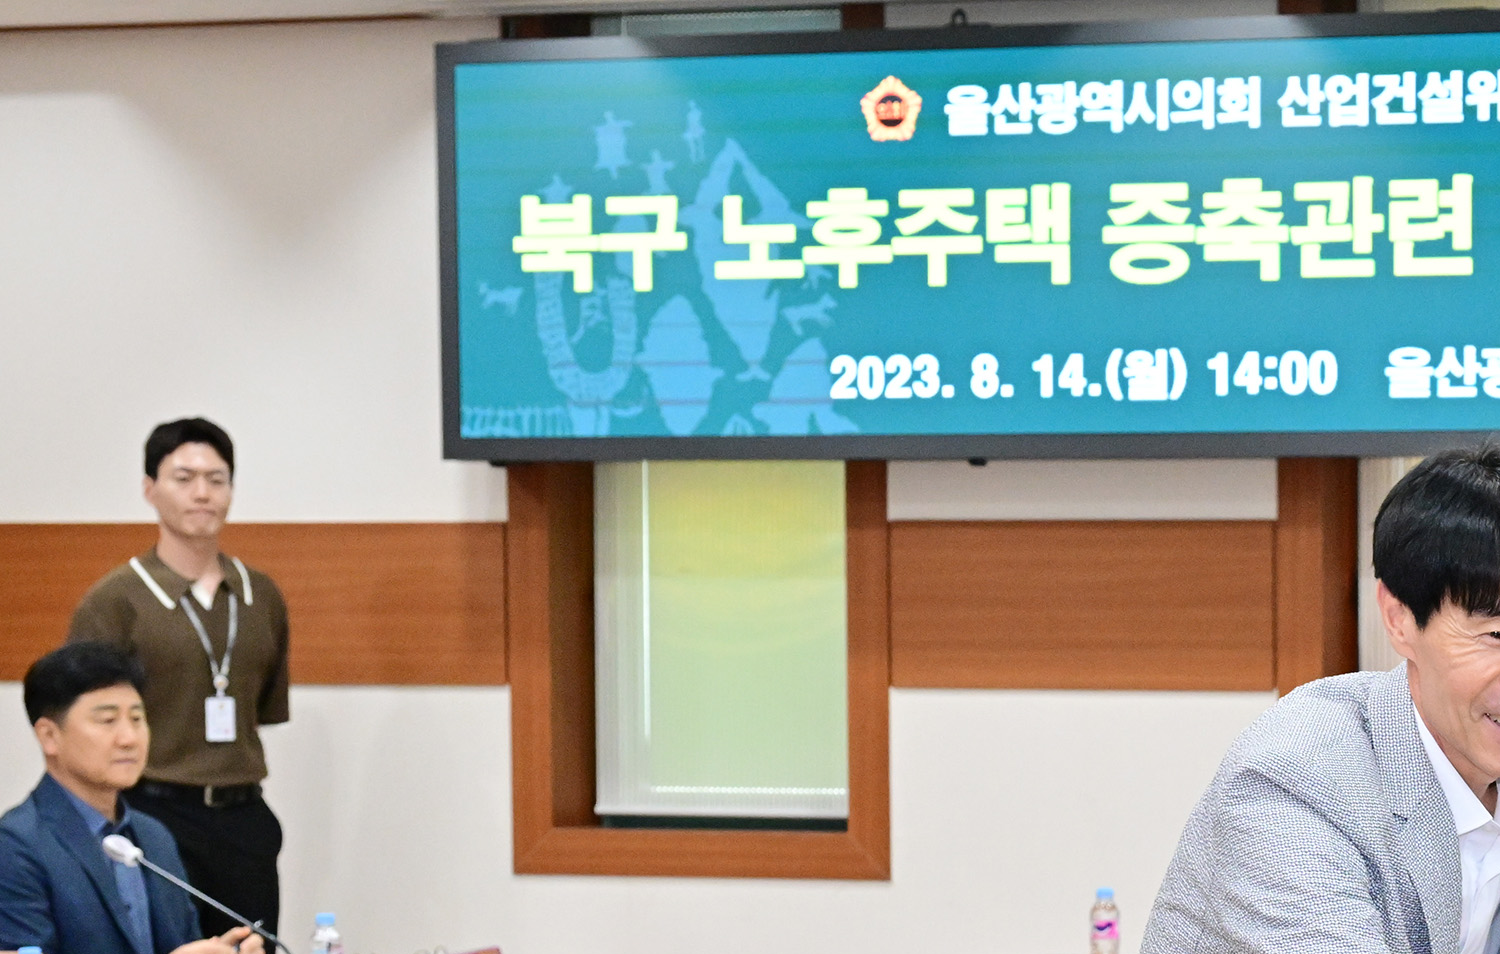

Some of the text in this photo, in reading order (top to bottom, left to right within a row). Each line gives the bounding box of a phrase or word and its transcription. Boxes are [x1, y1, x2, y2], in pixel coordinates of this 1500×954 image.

[944, 76, 1261, 135] 울산광역시의회
[512, 194, 688, 293] 북구
[714, 182, 1071, 289] 노후주택
[1102, 173, 1474, 285] 증축관련
[829, 354, 955, 400] 2023.
[970, 353, 1014, 399] 8.
[1032, 348, 1188, 401] 14.(월)
[1207, 350, 1338, 396] 14:00
